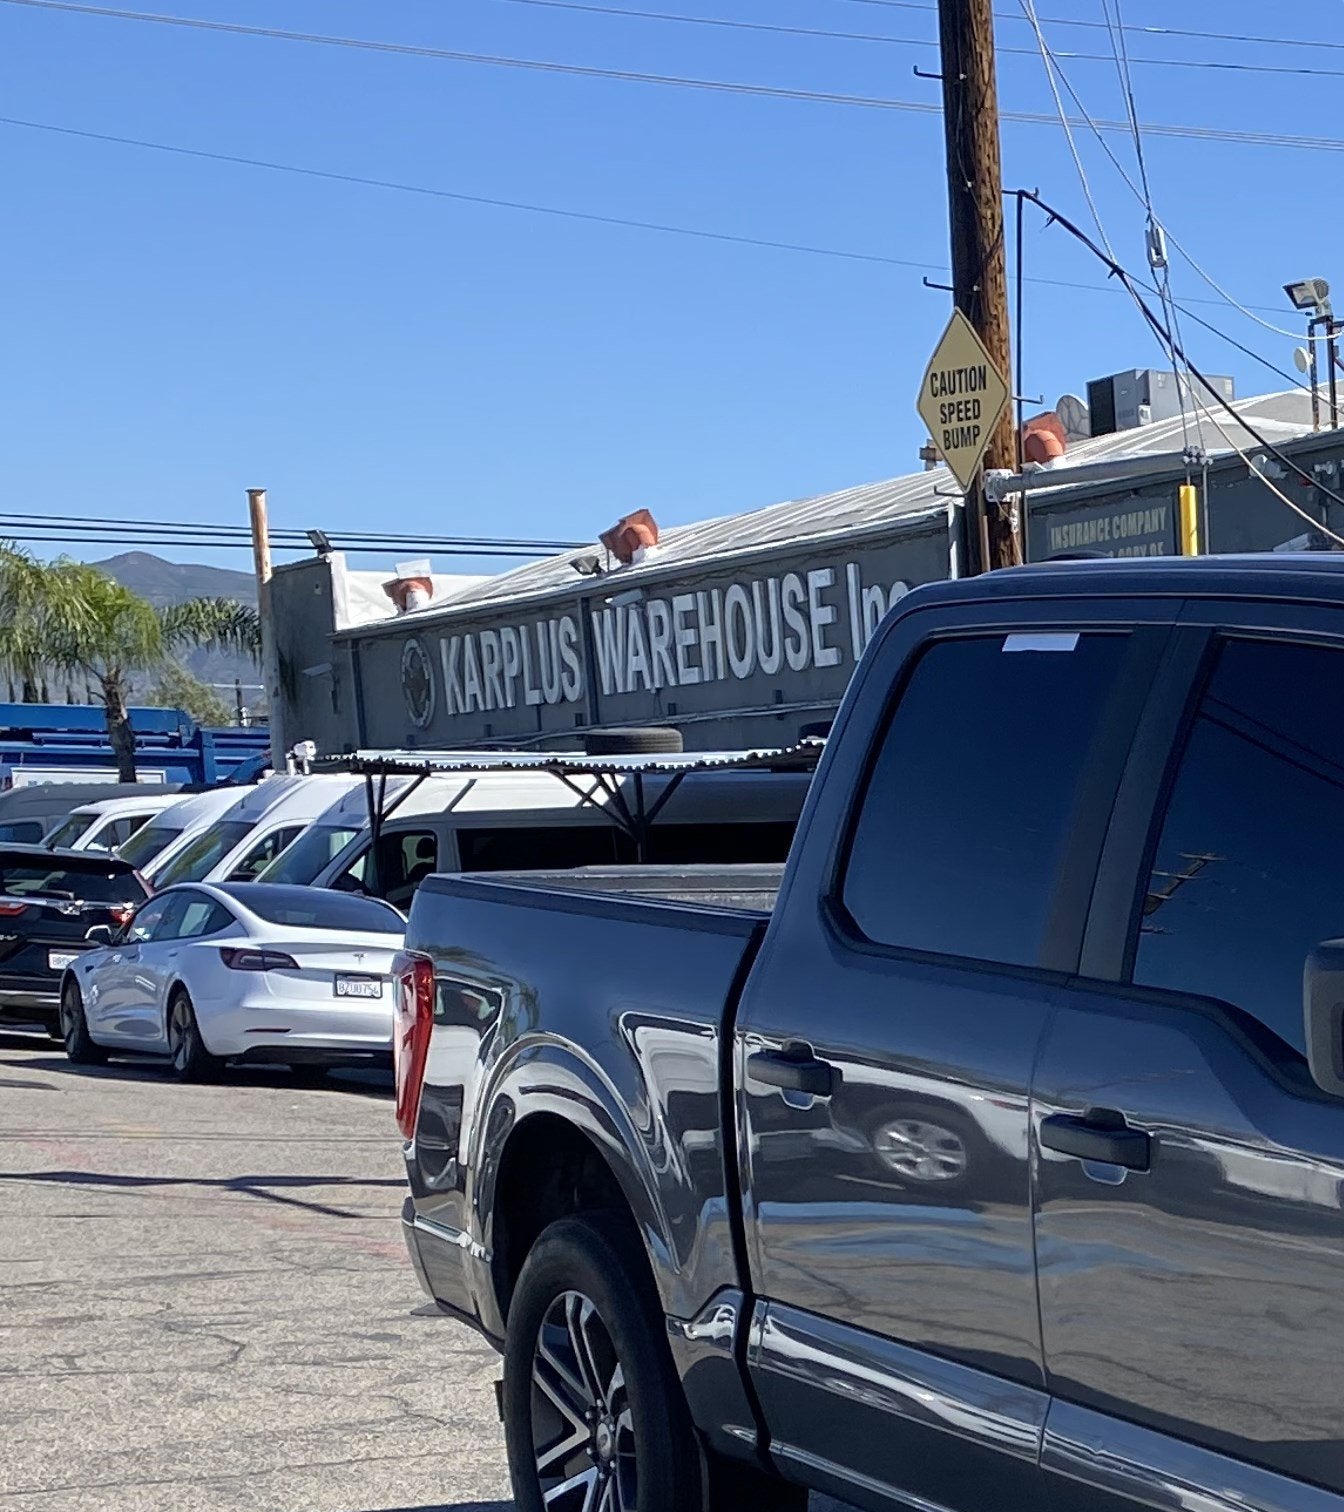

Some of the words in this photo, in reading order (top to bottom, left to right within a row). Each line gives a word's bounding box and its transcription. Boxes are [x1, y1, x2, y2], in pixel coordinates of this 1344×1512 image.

[930, 365, 987, 398] CAUTION
[940, 399, 981, 425] SPEED
[943, 425, 981, 451] BUMP
[1051, 517, 1110, 550] INSURANCE
[1111, 507, 1166, 539] COMPANY
[440, 616, 582, 715] KARPLUS
[591, 568, 841, 695] WAREHOUSE
